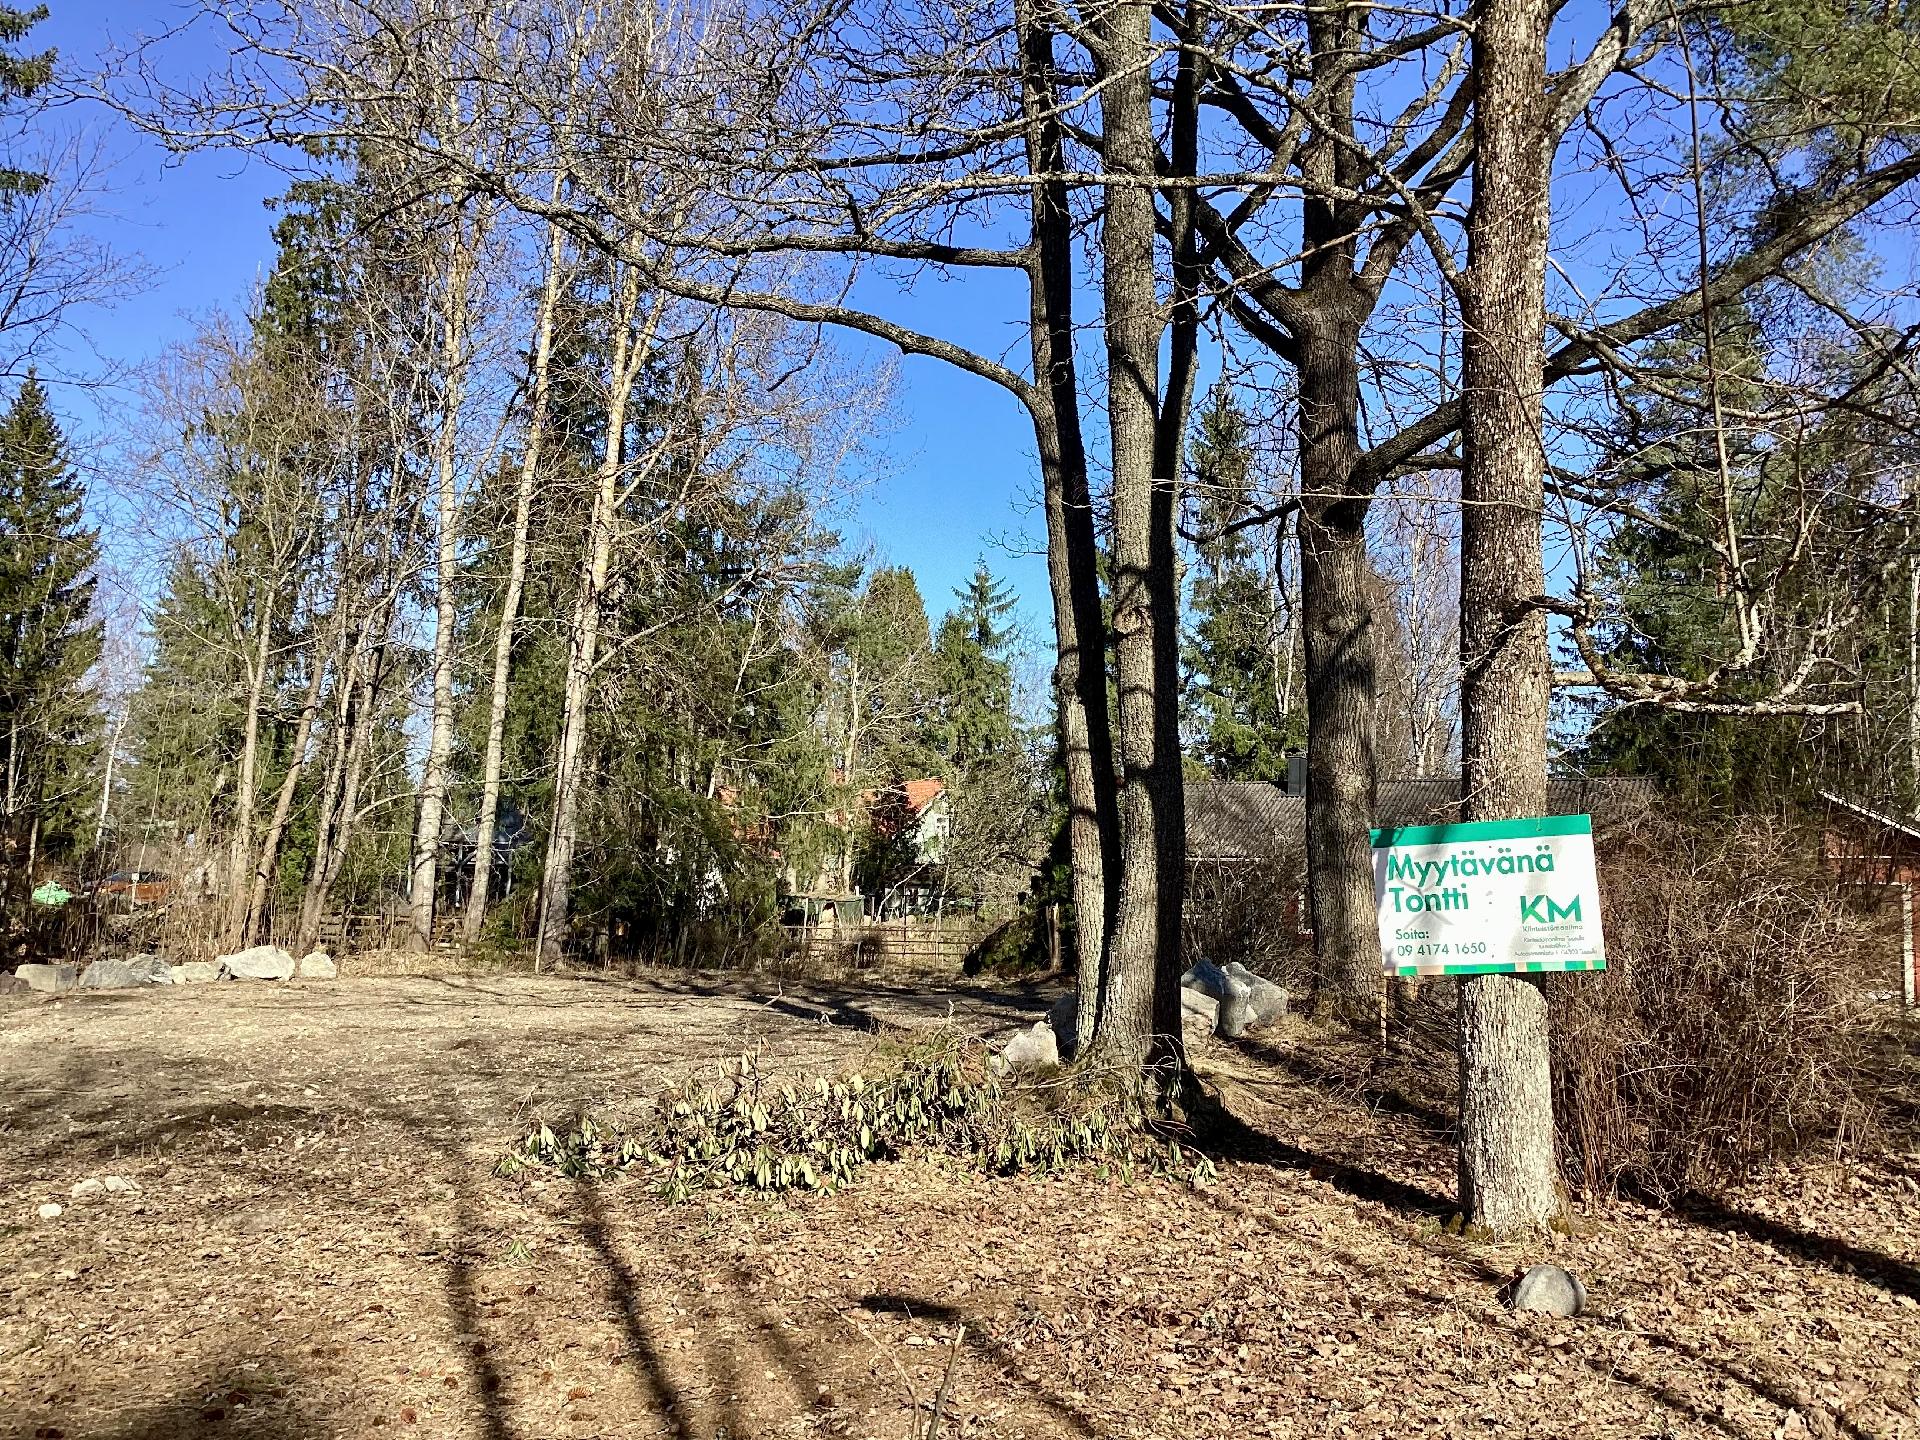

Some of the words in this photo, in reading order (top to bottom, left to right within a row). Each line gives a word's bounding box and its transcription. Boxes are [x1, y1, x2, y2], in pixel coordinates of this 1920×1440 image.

[1388, 845, 1555, 887] Myytävänä
[1388, 883, 1469, 913] Tontti
[1520, 894, 1582, 924] KM
[1395, 928, 1430, 940] Soita:
[1397, 945, 1413, 957] 09
[1417, 943, 1450, 955] 4174
[1455, 941, 1487, 954] 1650
